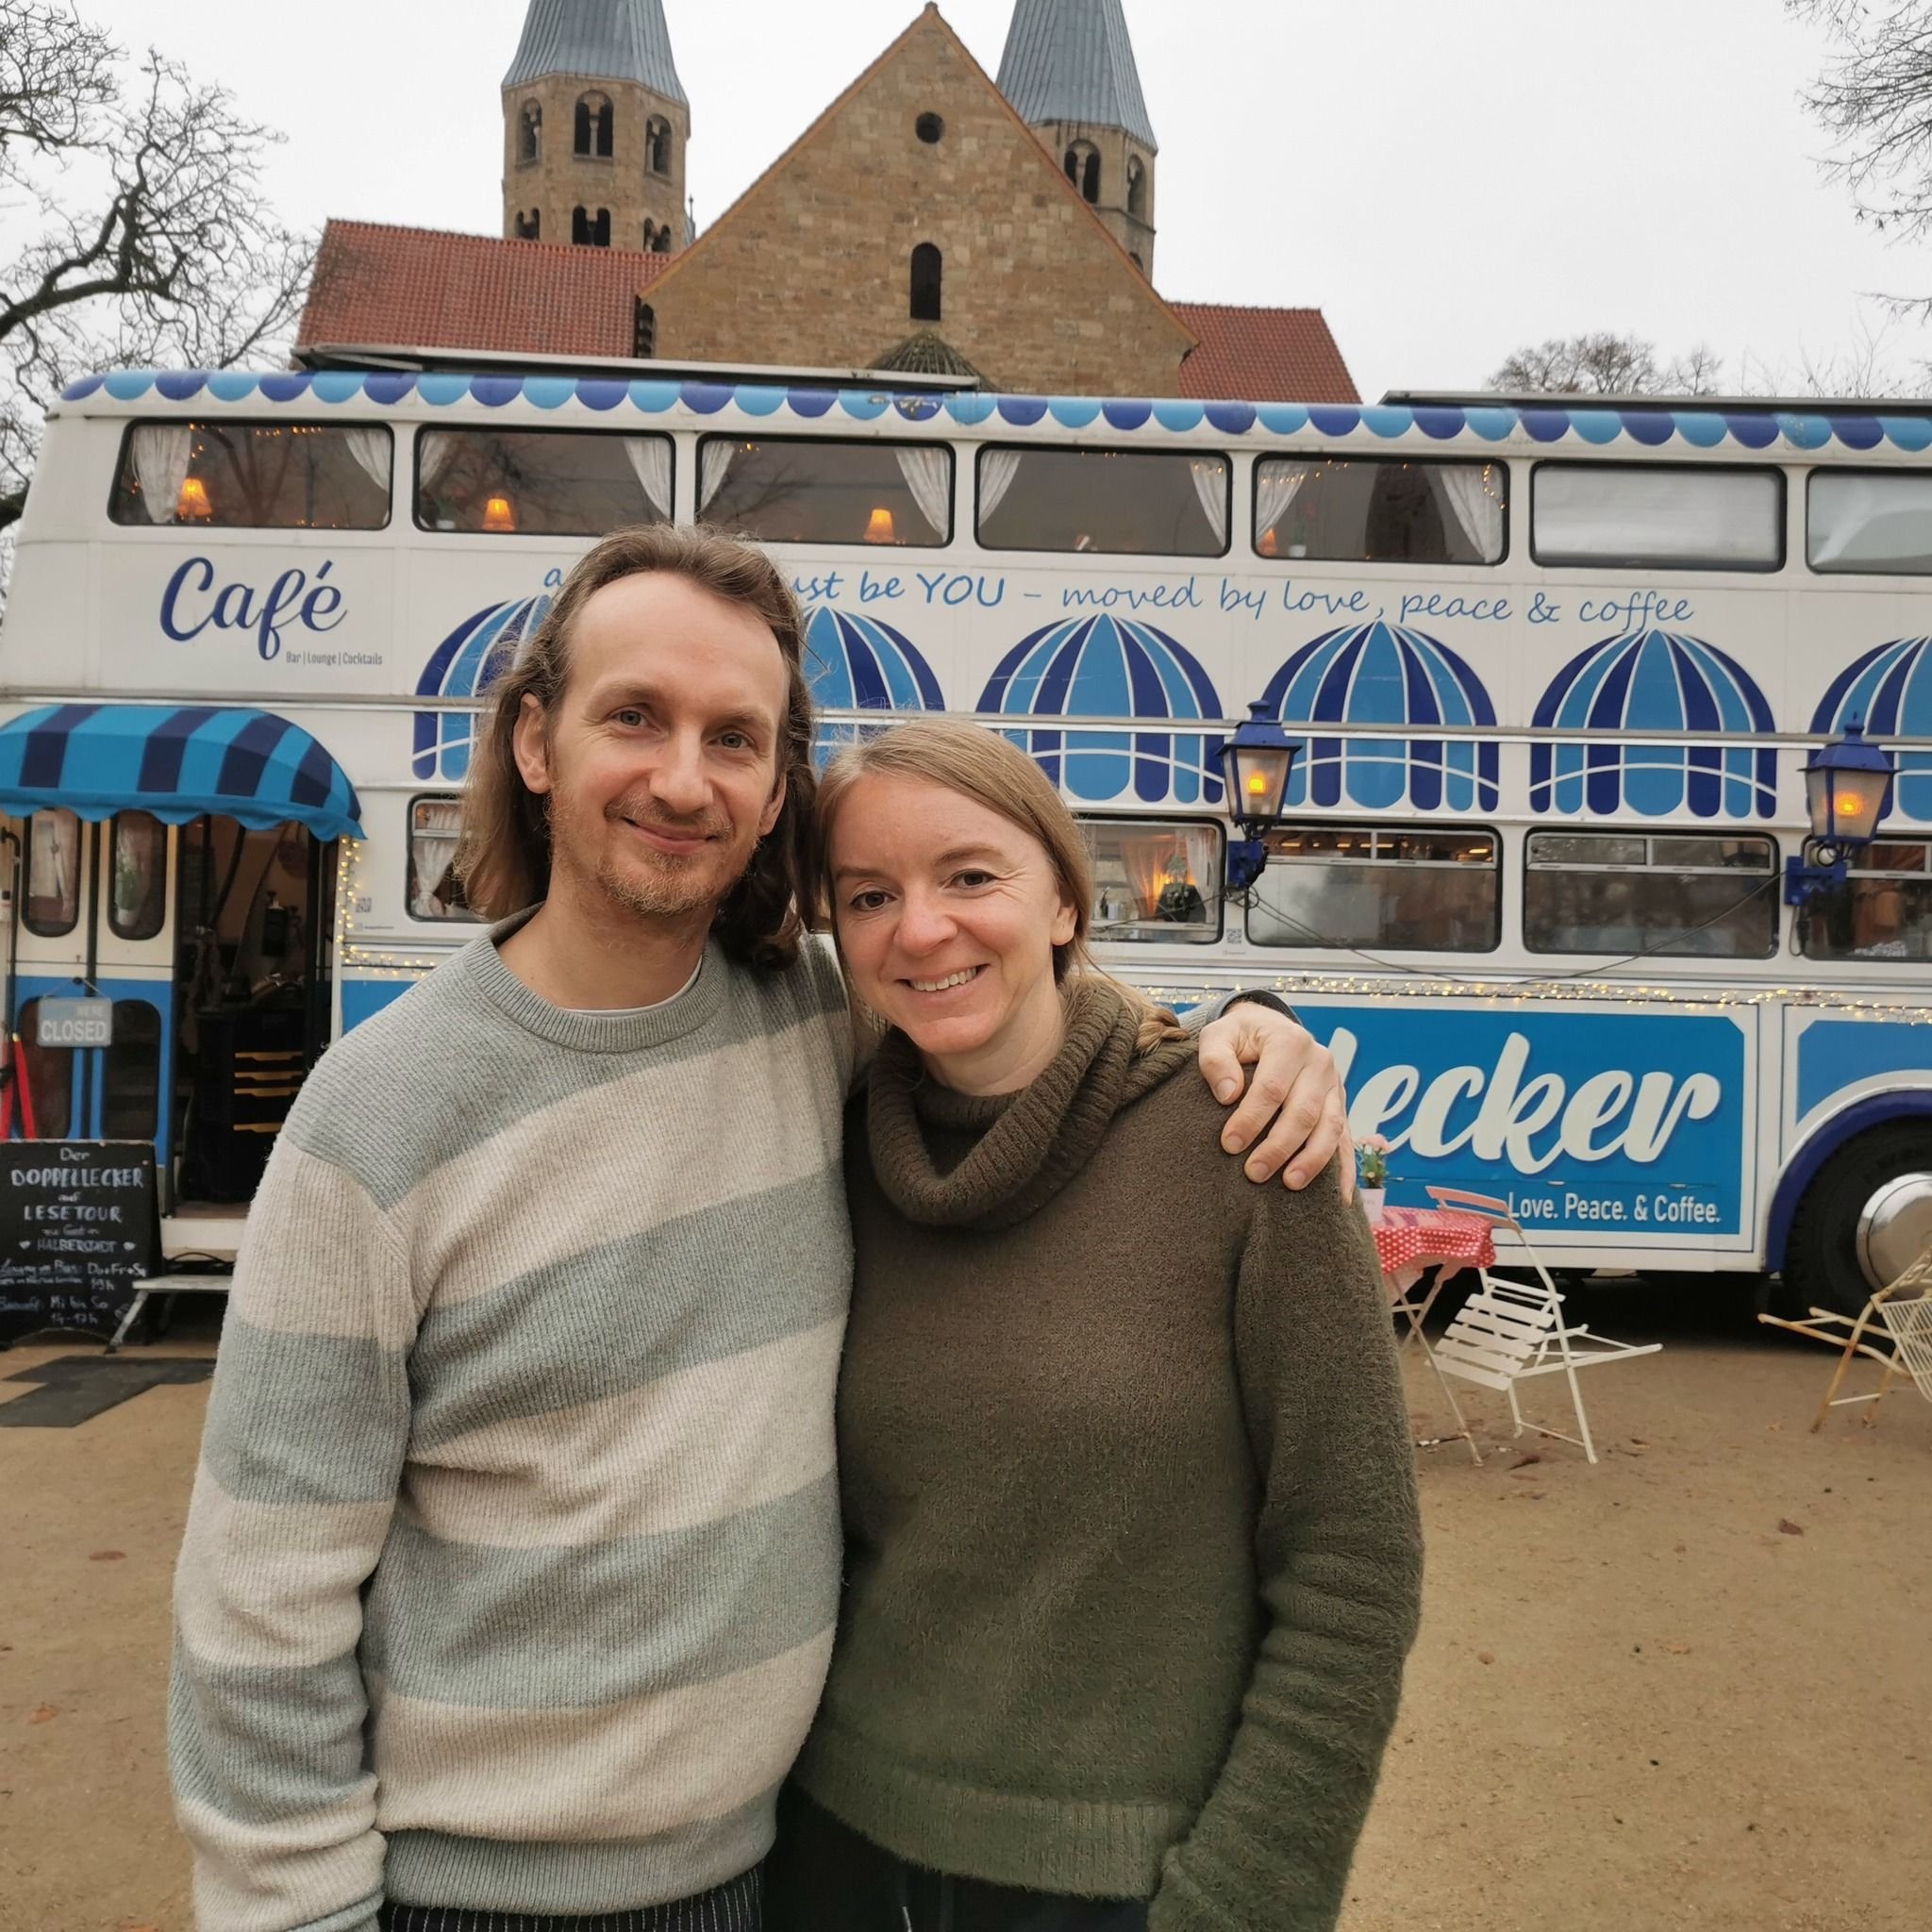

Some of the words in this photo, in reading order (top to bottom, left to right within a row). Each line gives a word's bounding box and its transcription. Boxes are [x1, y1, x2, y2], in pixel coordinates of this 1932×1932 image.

[159, 557, 348, 660] Café
[792, 571, 844, 601] ust
[859, 571, 907, 604] be
[916, 572, 1006, 608] YOU
[1062, 575, 1203, 609] moved
[1221, 577, 1266, 620] by
[1283, 579, 1385, 619] love,
[1400, 593, 1513, 624] peace
[1527, 591, 1561, 624] &
[1578, 591, 1695, 633] coffee
[286, 651, 301, 664] Bar
[308, 652, 337, 666] Lounge
[342, 653, 383, 665] Cocktails
[41, 1020, 107, 1041] CLOSED
[60, 1147, 91, 1161] Der
[1509, 1191, 1558, 1219] Love.
[1564, 1192, 1628, 1221] Peace.
[1634, 1194, 1649, 1221] &
[1654, 1194, 1721, 1224] Coffee.
